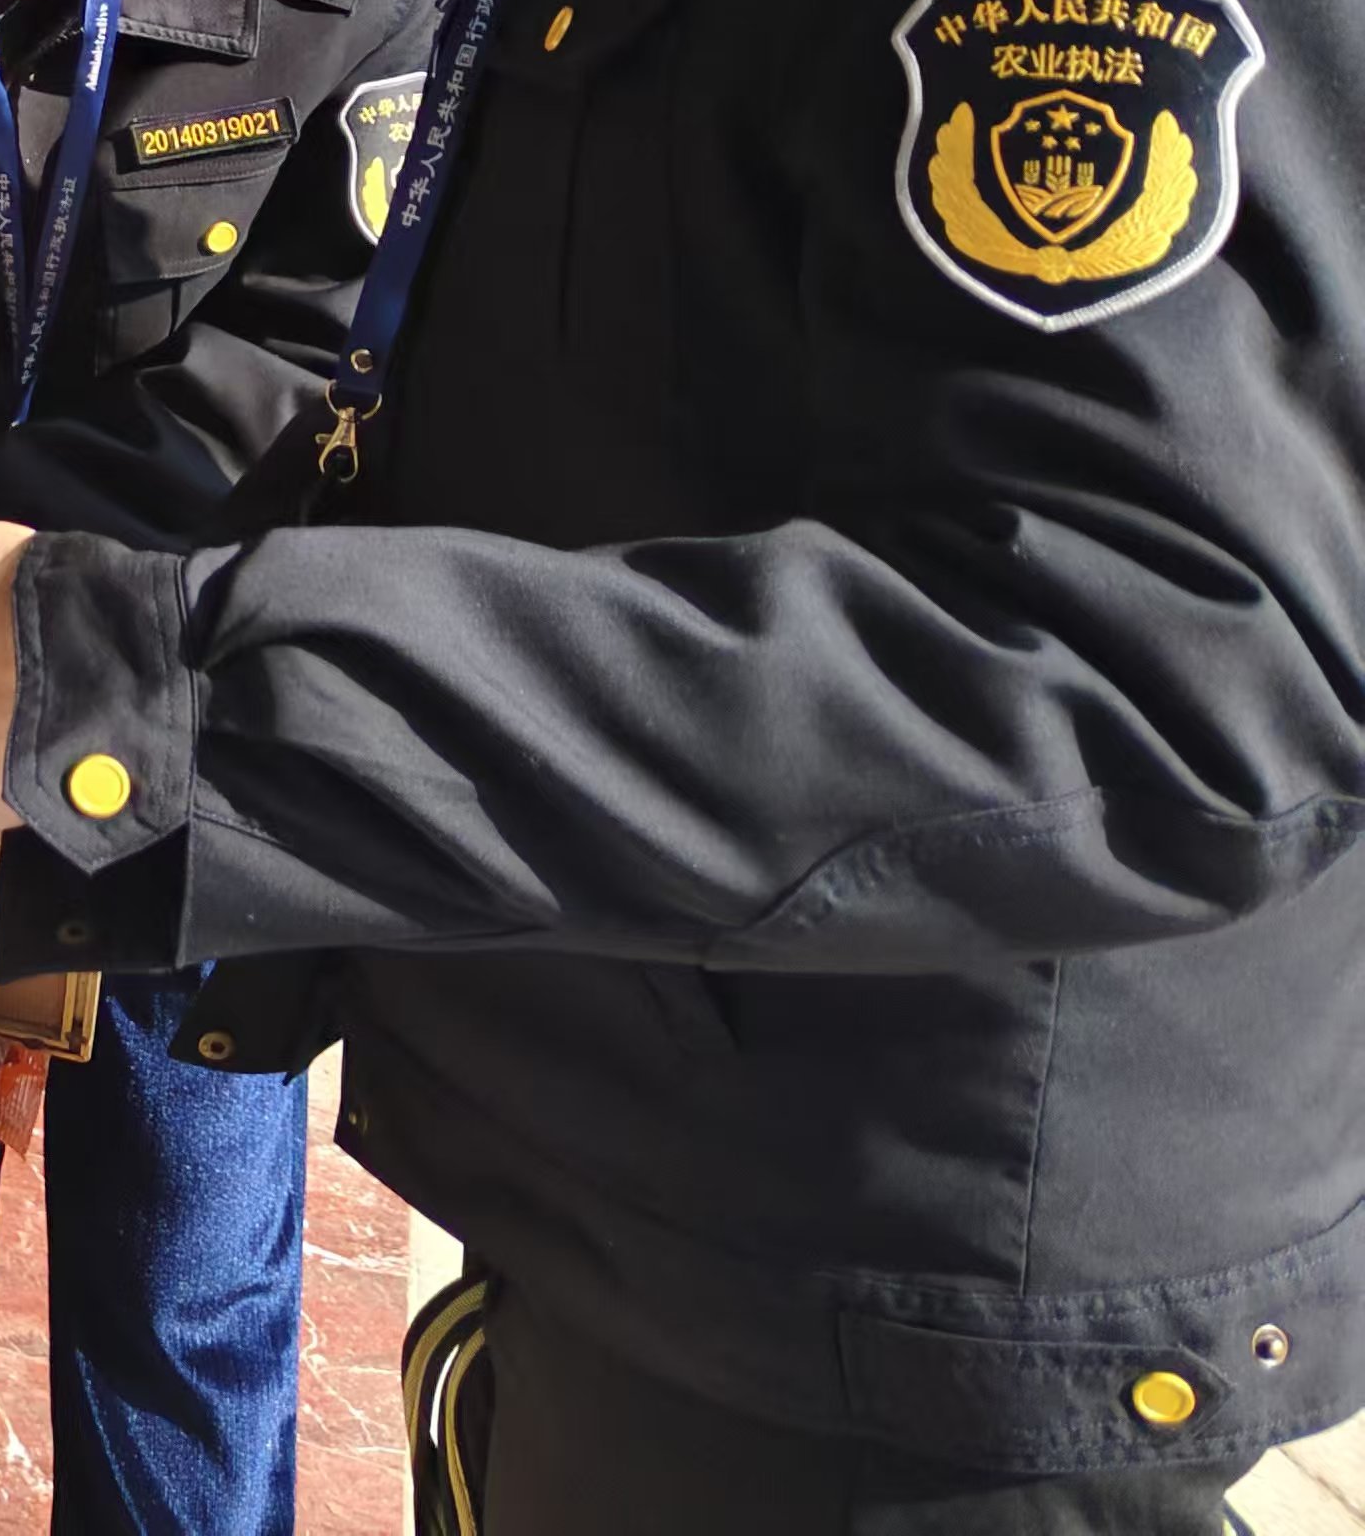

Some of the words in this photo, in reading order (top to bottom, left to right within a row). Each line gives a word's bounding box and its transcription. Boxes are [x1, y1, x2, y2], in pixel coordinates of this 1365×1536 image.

[990, 43, 1145, 86] 农业执法
[141, 108, 281, 157] 20140319021
